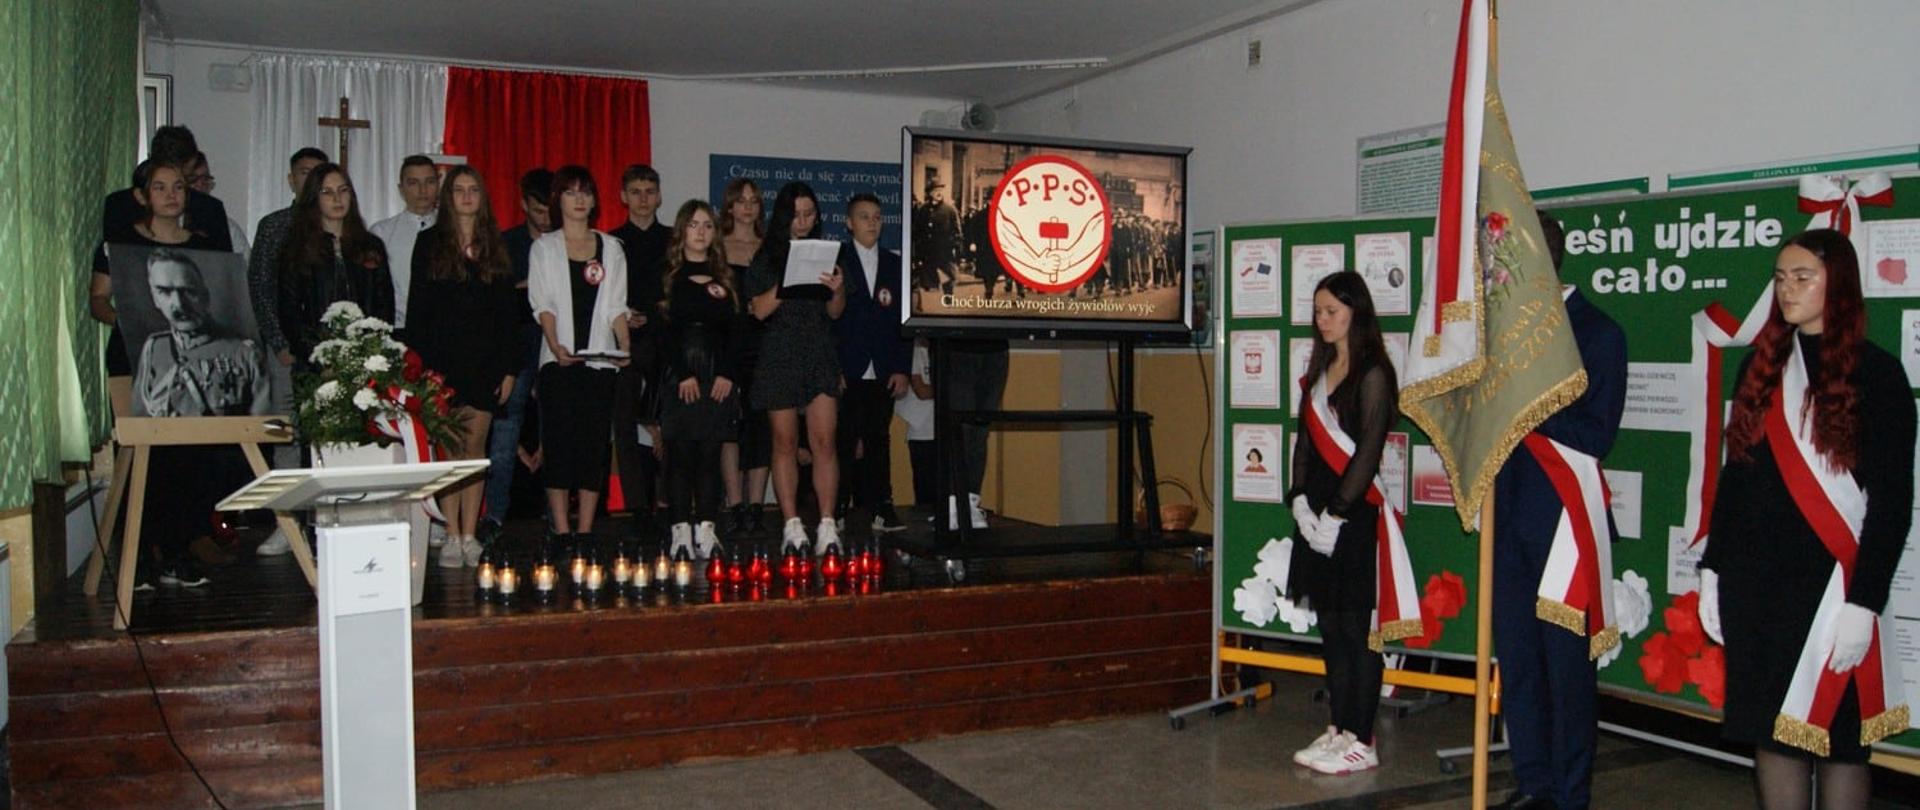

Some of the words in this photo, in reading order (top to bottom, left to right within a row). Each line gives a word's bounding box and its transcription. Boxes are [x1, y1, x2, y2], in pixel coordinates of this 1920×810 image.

[775, 168, 794, 180] nie
[798, 168, 813, 181] da
[817, 170, 834, 184] się
[1558, 210, 1634, 255] eśń
[1654, 205, 1783, 258] ujdzie
[941, 294, 973, 308] Choć
[977, 296, 1012, 309] burza
[1016, 298, 1065, 314] wrogich
[1128, 301, 1155, 316] wyje
